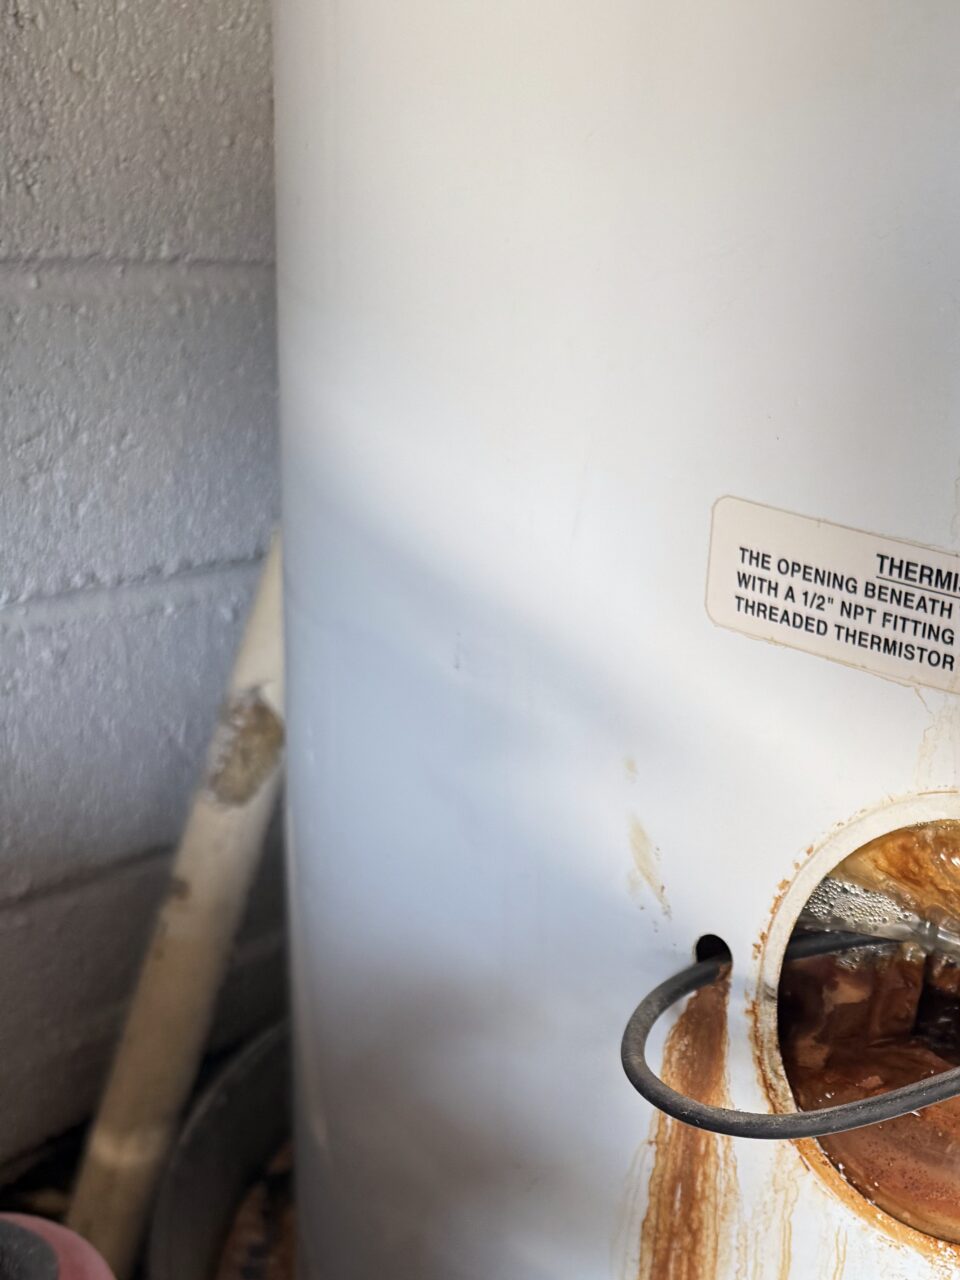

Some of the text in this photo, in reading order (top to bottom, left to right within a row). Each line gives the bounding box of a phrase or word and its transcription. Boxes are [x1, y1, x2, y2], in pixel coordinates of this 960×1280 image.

[736, 571, 779, 598] WITH
[784, 586, 796, 604] A
[802, 590, 834, 612] 1/2"
[840, 601, 877, 625] NPT
[882, 613, 955, 646] FITTING
[739, 547, 772, 570] THE
[777, 558, 858, 594] OPENING
[864, 581, 953, 619] BENEATH
[735, 595, 828, 636] THREADED
[834, 624, 955, 671] THERMISTOR
